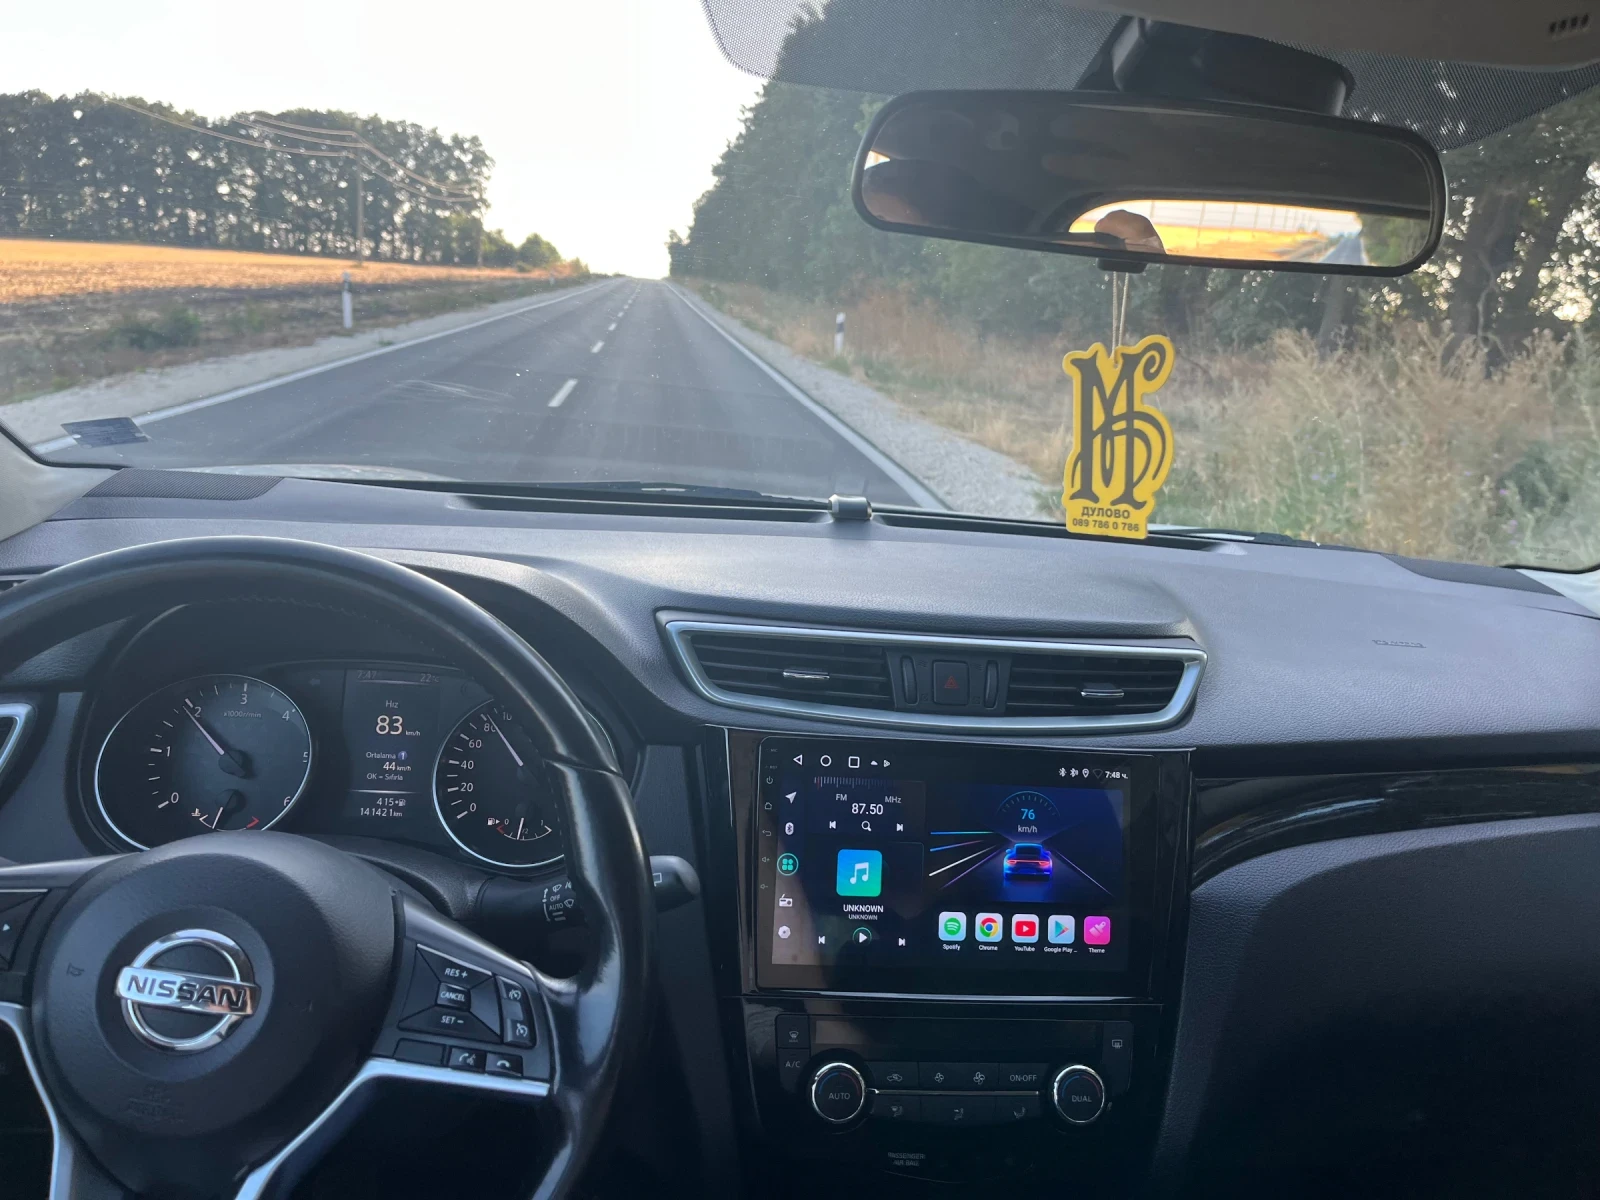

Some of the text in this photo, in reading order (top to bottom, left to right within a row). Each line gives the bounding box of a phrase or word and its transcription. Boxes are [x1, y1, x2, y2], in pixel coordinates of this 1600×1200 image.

[1081, 506, 1130, 519] ДУЛОВО
[1072, 518, 1139, 532] 089 786 0 786
[240, 694, 248, 705] 3
[194, 706, 202, 718] 2
[282, 710, 290, 721] 4
[376, 715, 403, 735] 83
[468, 739, 482, 748] 60
[166, 746, 171, 757] 1
[383, 761, 396, 771] 44
[460, 760, 474, 770] 40
[1105, 770, 1120, 779] 7:48
[460, 782, 474, 792] 20
[171, 792, 179, 804] 0
[377, 797, 394, 806] 415
[835, 793, 848, 801] FM
[885, 795, 902, 804] MHz
[470, 803, 477, 812] 0
[851, 803, 884, 815] 87.50
[1021, 808, 1036, 820] 76
[1017, 825, 1038, 833] km/h
[549, 902, 564, 911] AUTO
[843, 904, 884, 913] UNKNOWN
[444, 967, 460, 977] RES
[127, 974, 247, 1009] NISSAN
[440, 991, 465, 1002] CANCEL
[441, 1015, 456, 1024] SET
[1009, 1074, 1038, 1082] ON-OFF
[828, 1092, 851, 1100] AUTO
[1071, 1095, 1092, 1103] DUAL
